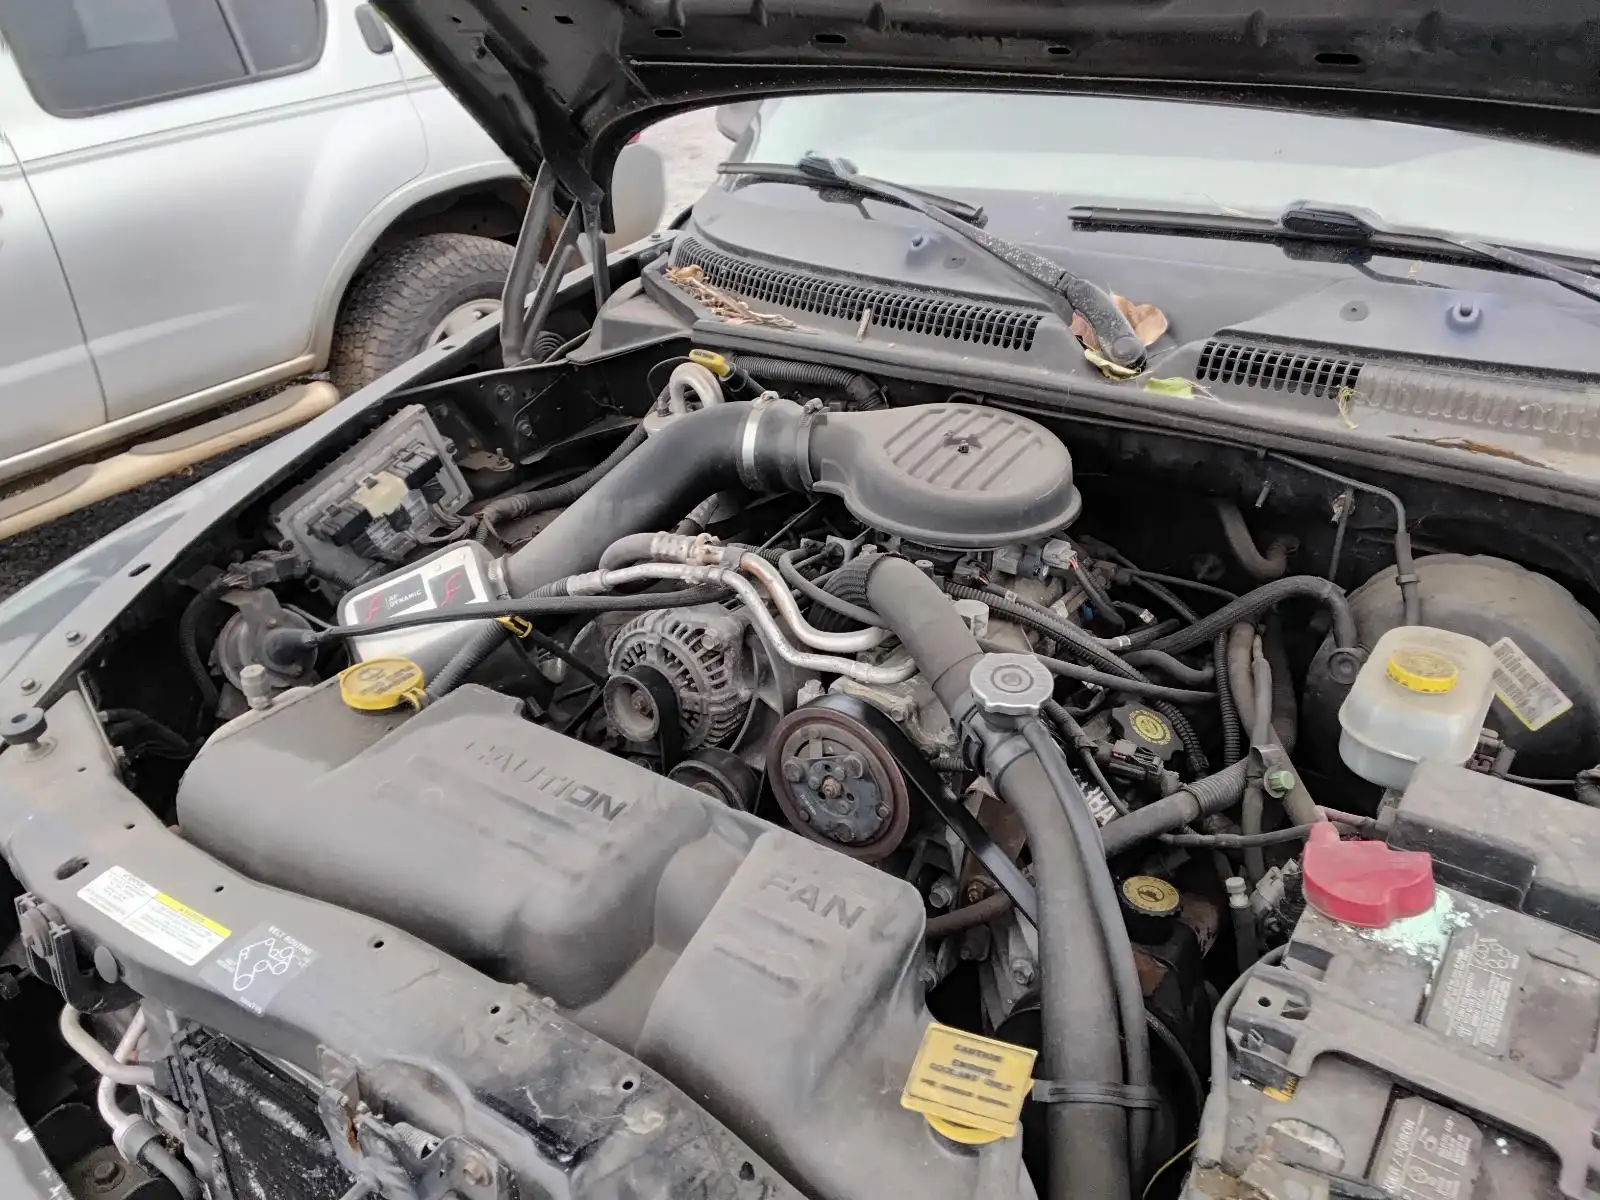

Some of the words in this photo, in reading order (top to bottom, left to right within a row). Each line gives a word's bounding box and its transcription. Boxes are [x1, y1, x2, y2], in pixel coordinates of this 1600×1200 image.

[388, 589, 423, 609] DYNAMIC
[464, 742, 628, 822] CAUTION
[759, 873, 867, 929] FAN
[953, 1042, 1005, 1064] CAUTION
